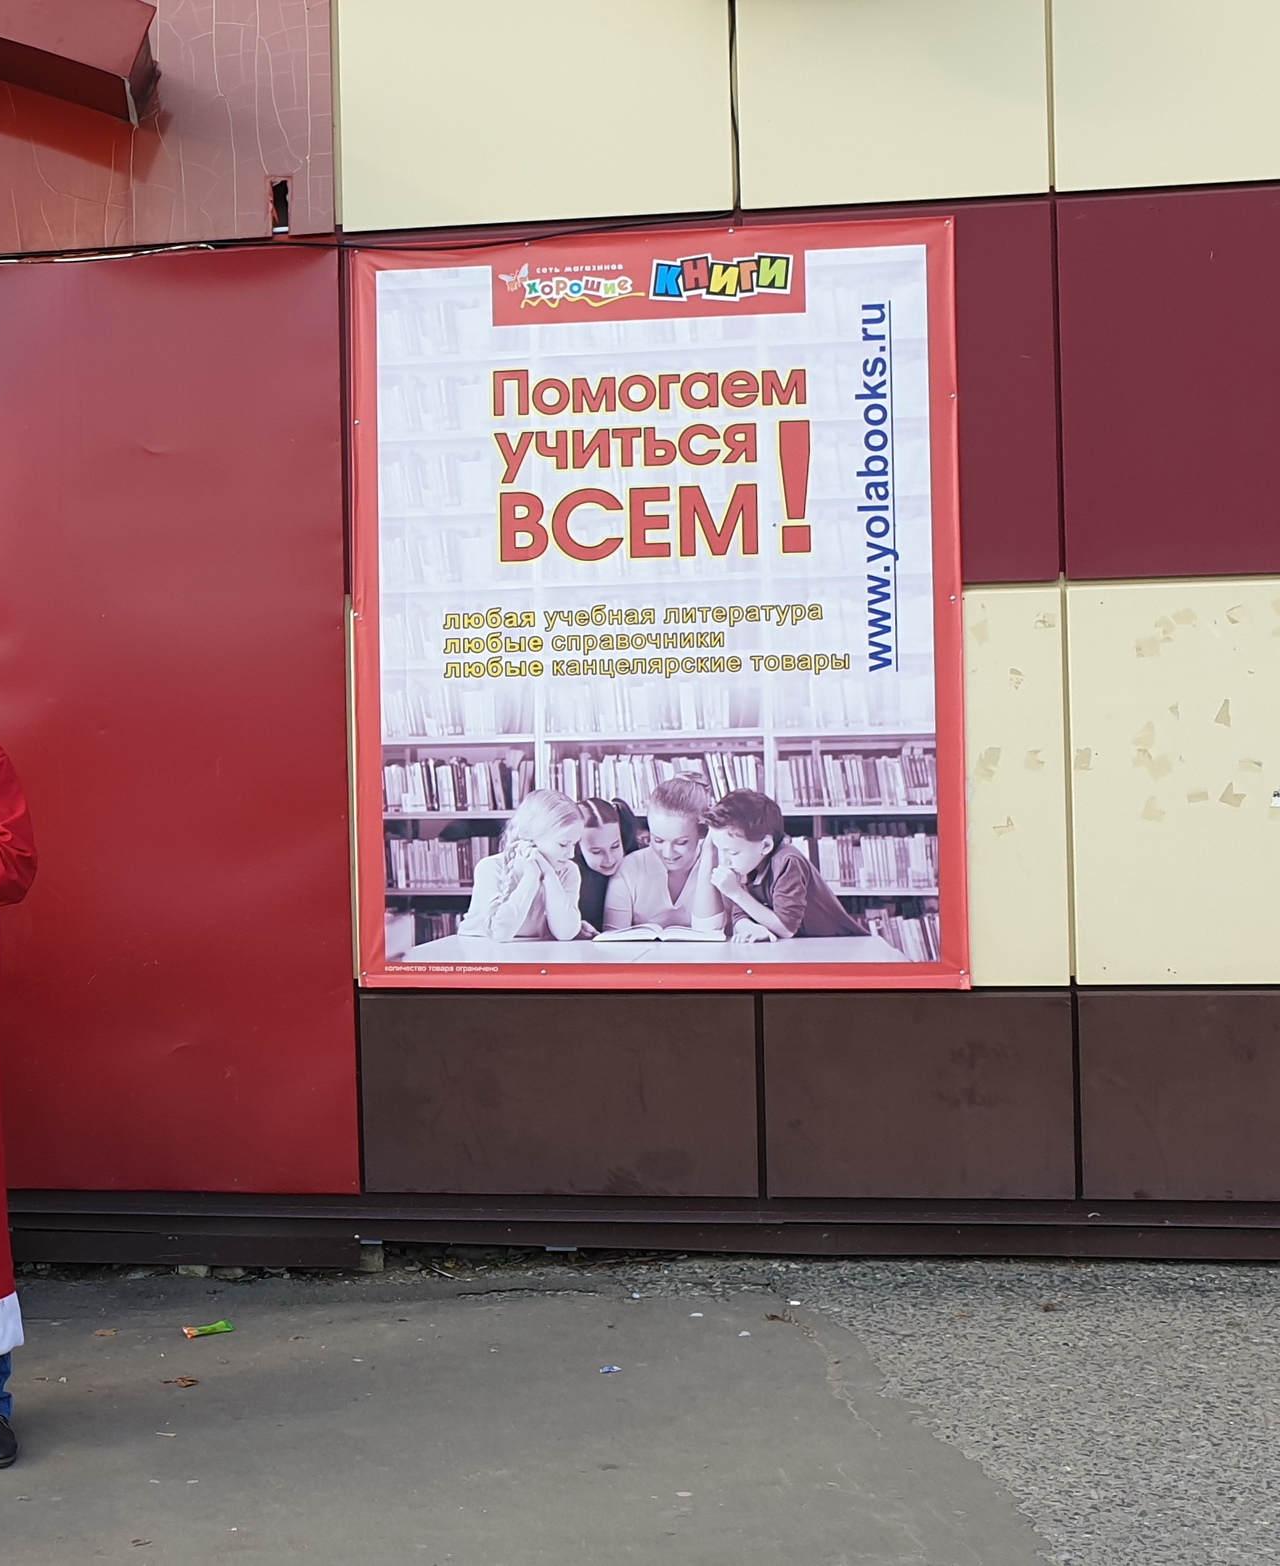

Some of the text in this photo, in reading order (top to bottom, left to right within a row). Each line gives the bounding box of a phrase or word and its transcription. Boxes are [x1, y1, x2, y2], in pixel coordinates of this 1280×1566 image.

[564, 263, 624, 274] магазинов
[492, 368, 807, 417] Помогаем
[493, 422, 758, 484] учиться
[854, 301, 899, 673] www.yolabooks.ru
[443, 603, 824, 632] любая учебная литература
[443, 631, 725, 656] любые справочники
[444, 653, 851, 679] любые канцелярские товары
[428, 965, 454, 974] товара
[455, 965, 499, 974] ограничено
